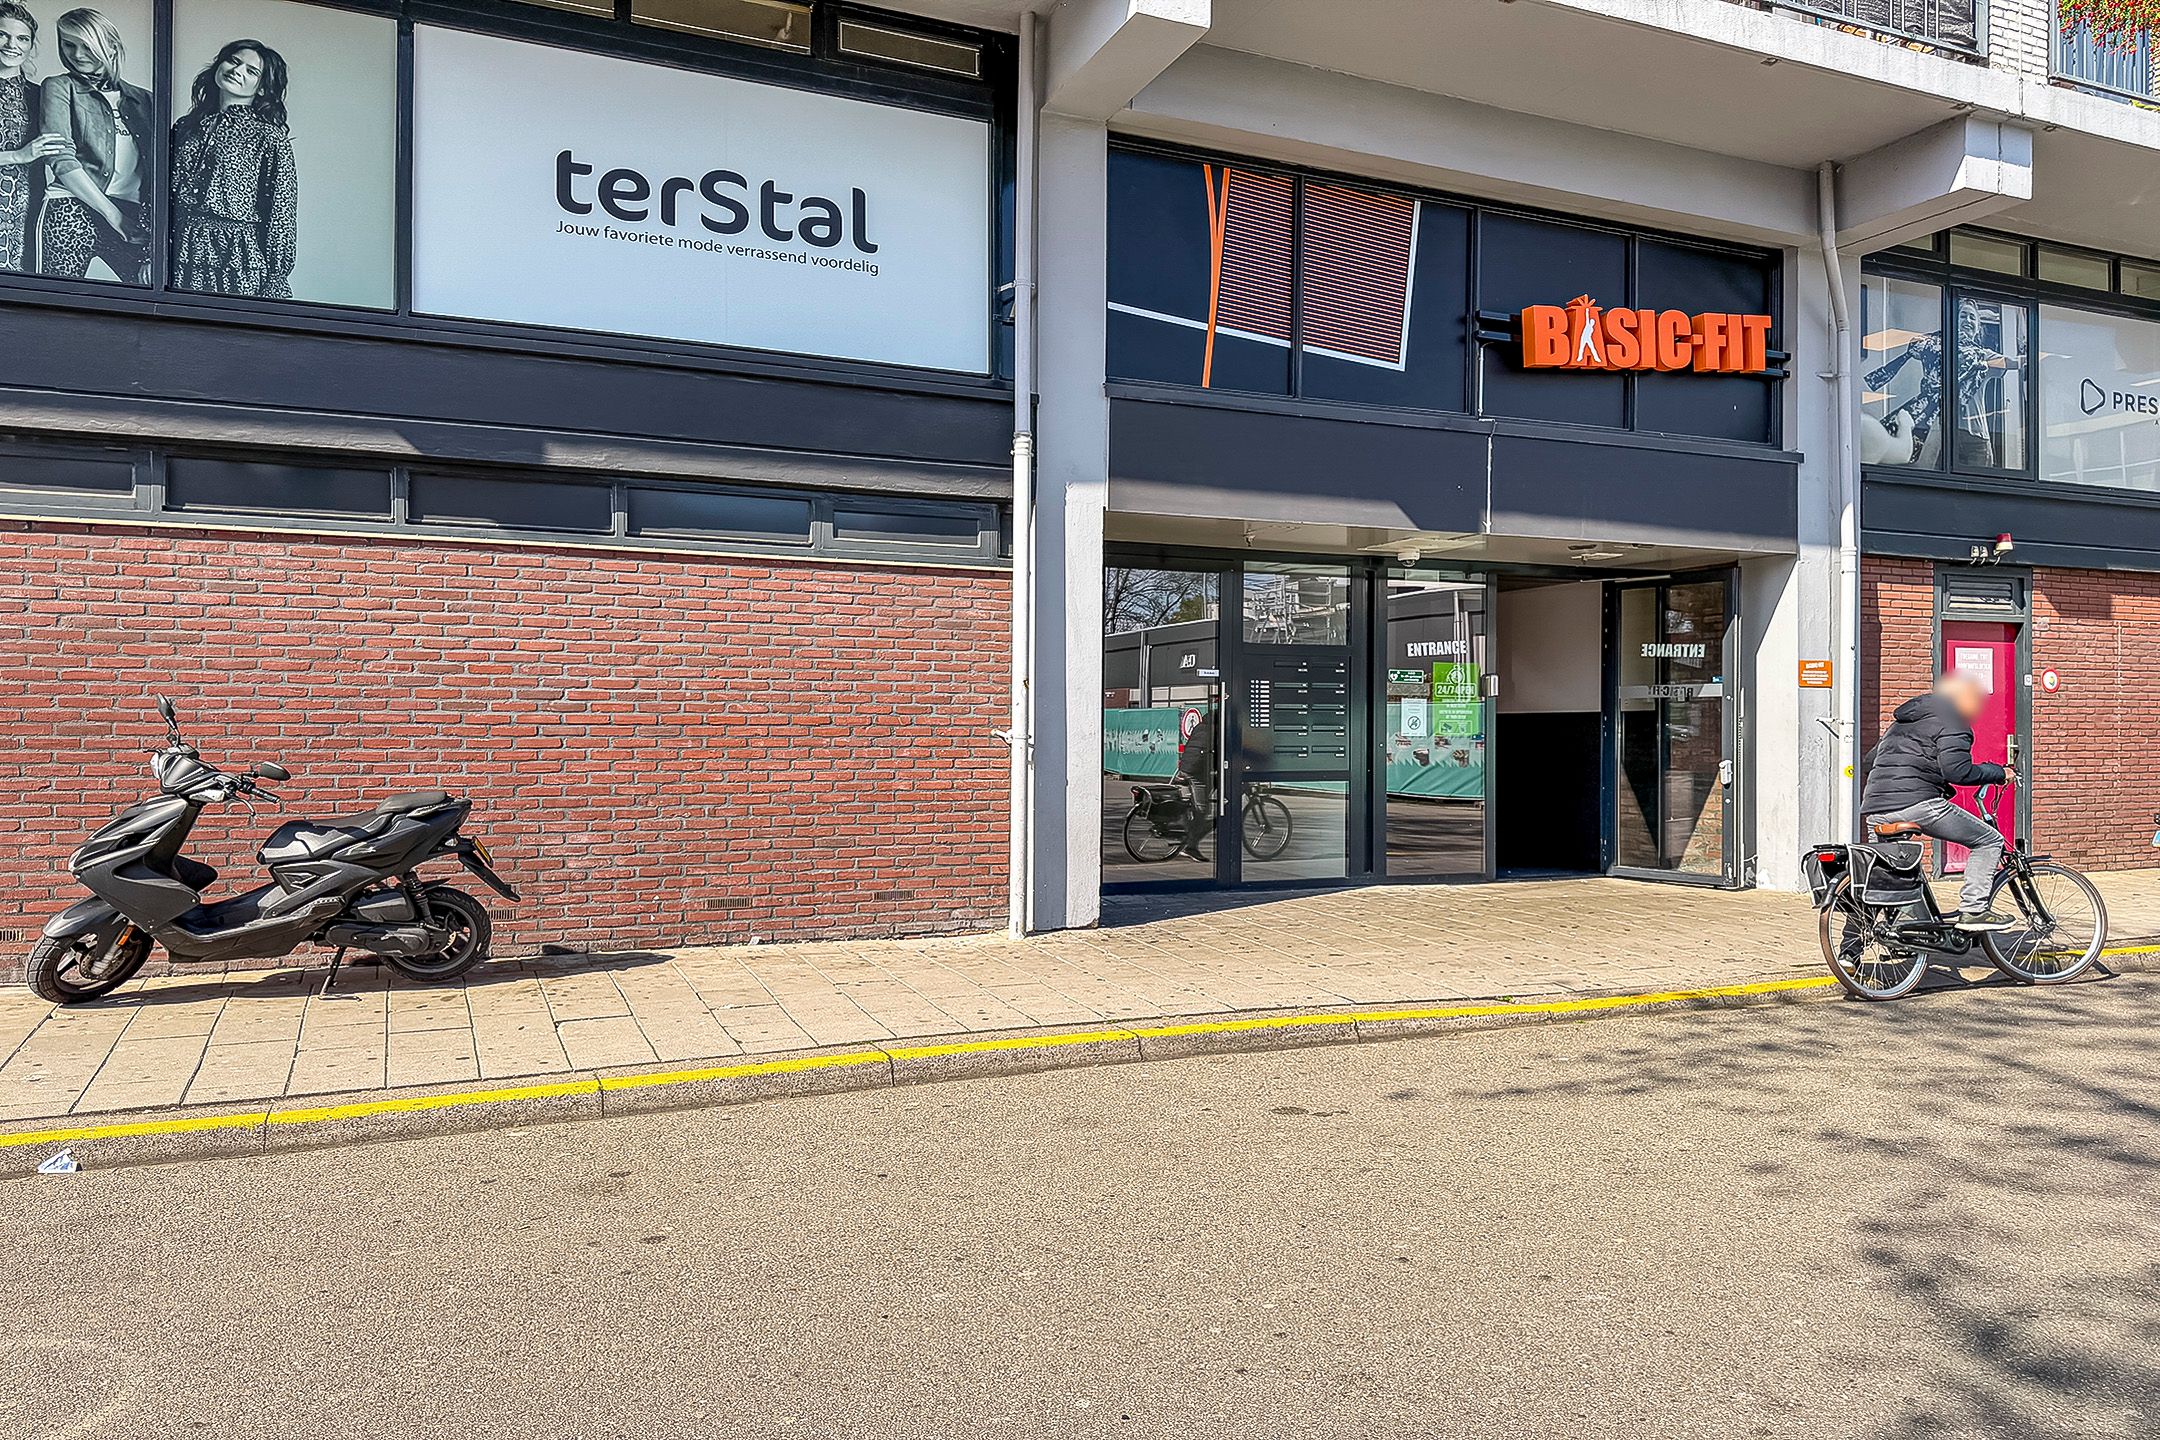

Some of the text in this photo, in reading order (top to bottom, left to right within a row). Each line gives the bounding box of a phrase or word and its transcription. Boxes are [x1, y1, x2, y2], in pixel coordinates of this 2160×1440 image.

[555, 149, 879, 254] terStal
[556, 220, 879, 277] Jouw favoriete mode verrassend voordelig
[1522, 296, 1772, 373] BASIC-FIT
[1407, 640, 1467, 657] ENTRANCE
